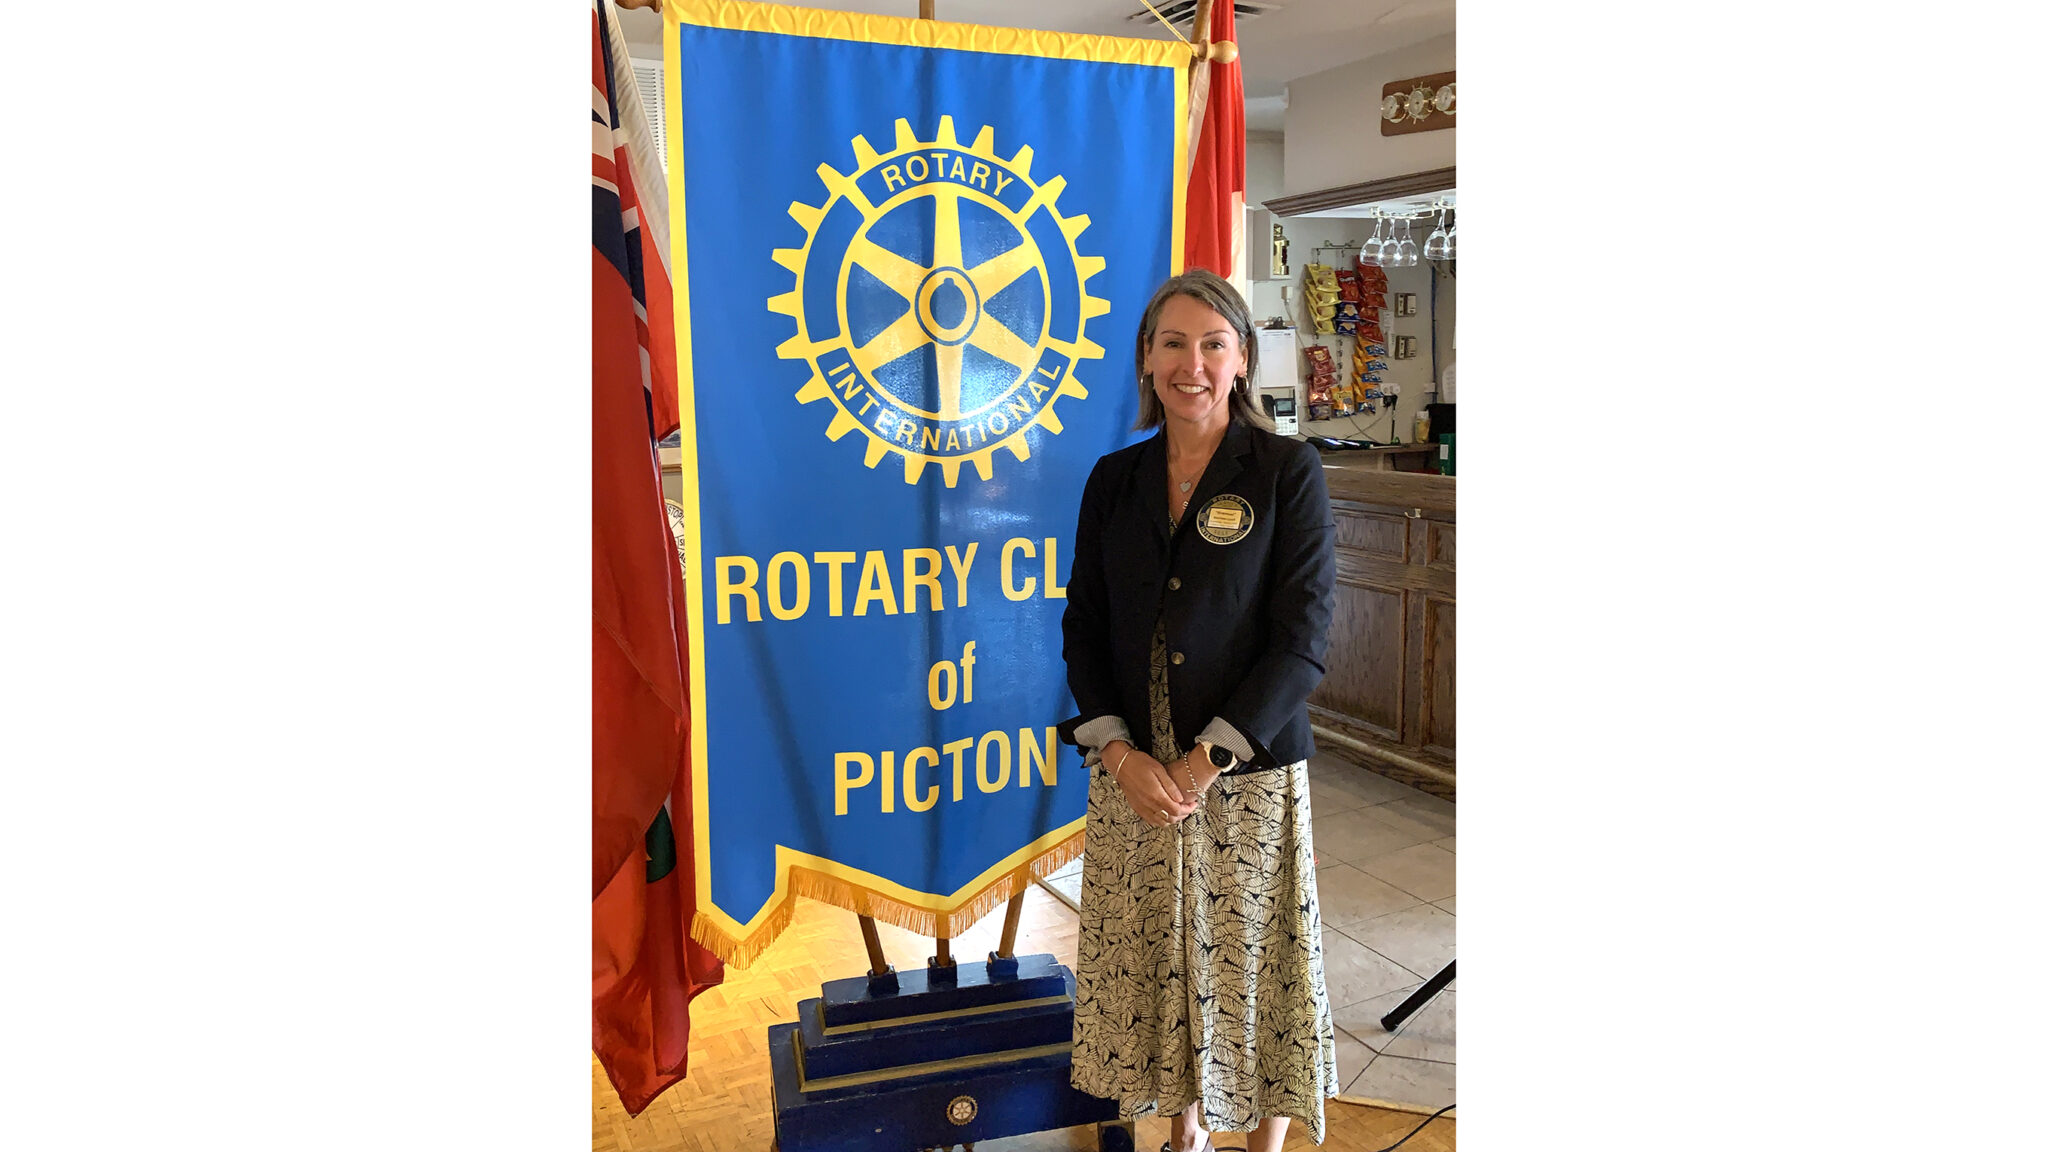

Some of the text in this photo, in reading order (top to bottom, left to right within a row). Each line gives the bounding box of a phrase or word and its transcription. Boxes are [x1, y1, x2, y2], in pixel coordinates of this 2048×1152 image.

[880, 153, 1014, 196] ROTARY
[828, 362, 1062, 451] INTERNATIONAL
[1200, 526, 1247, 543] INTERNATIONAL
[715, 537, 1067, 625] ROTARY CL
[928, 640, 976, 711] of
[834, 726, 1058, 816] PICTON
